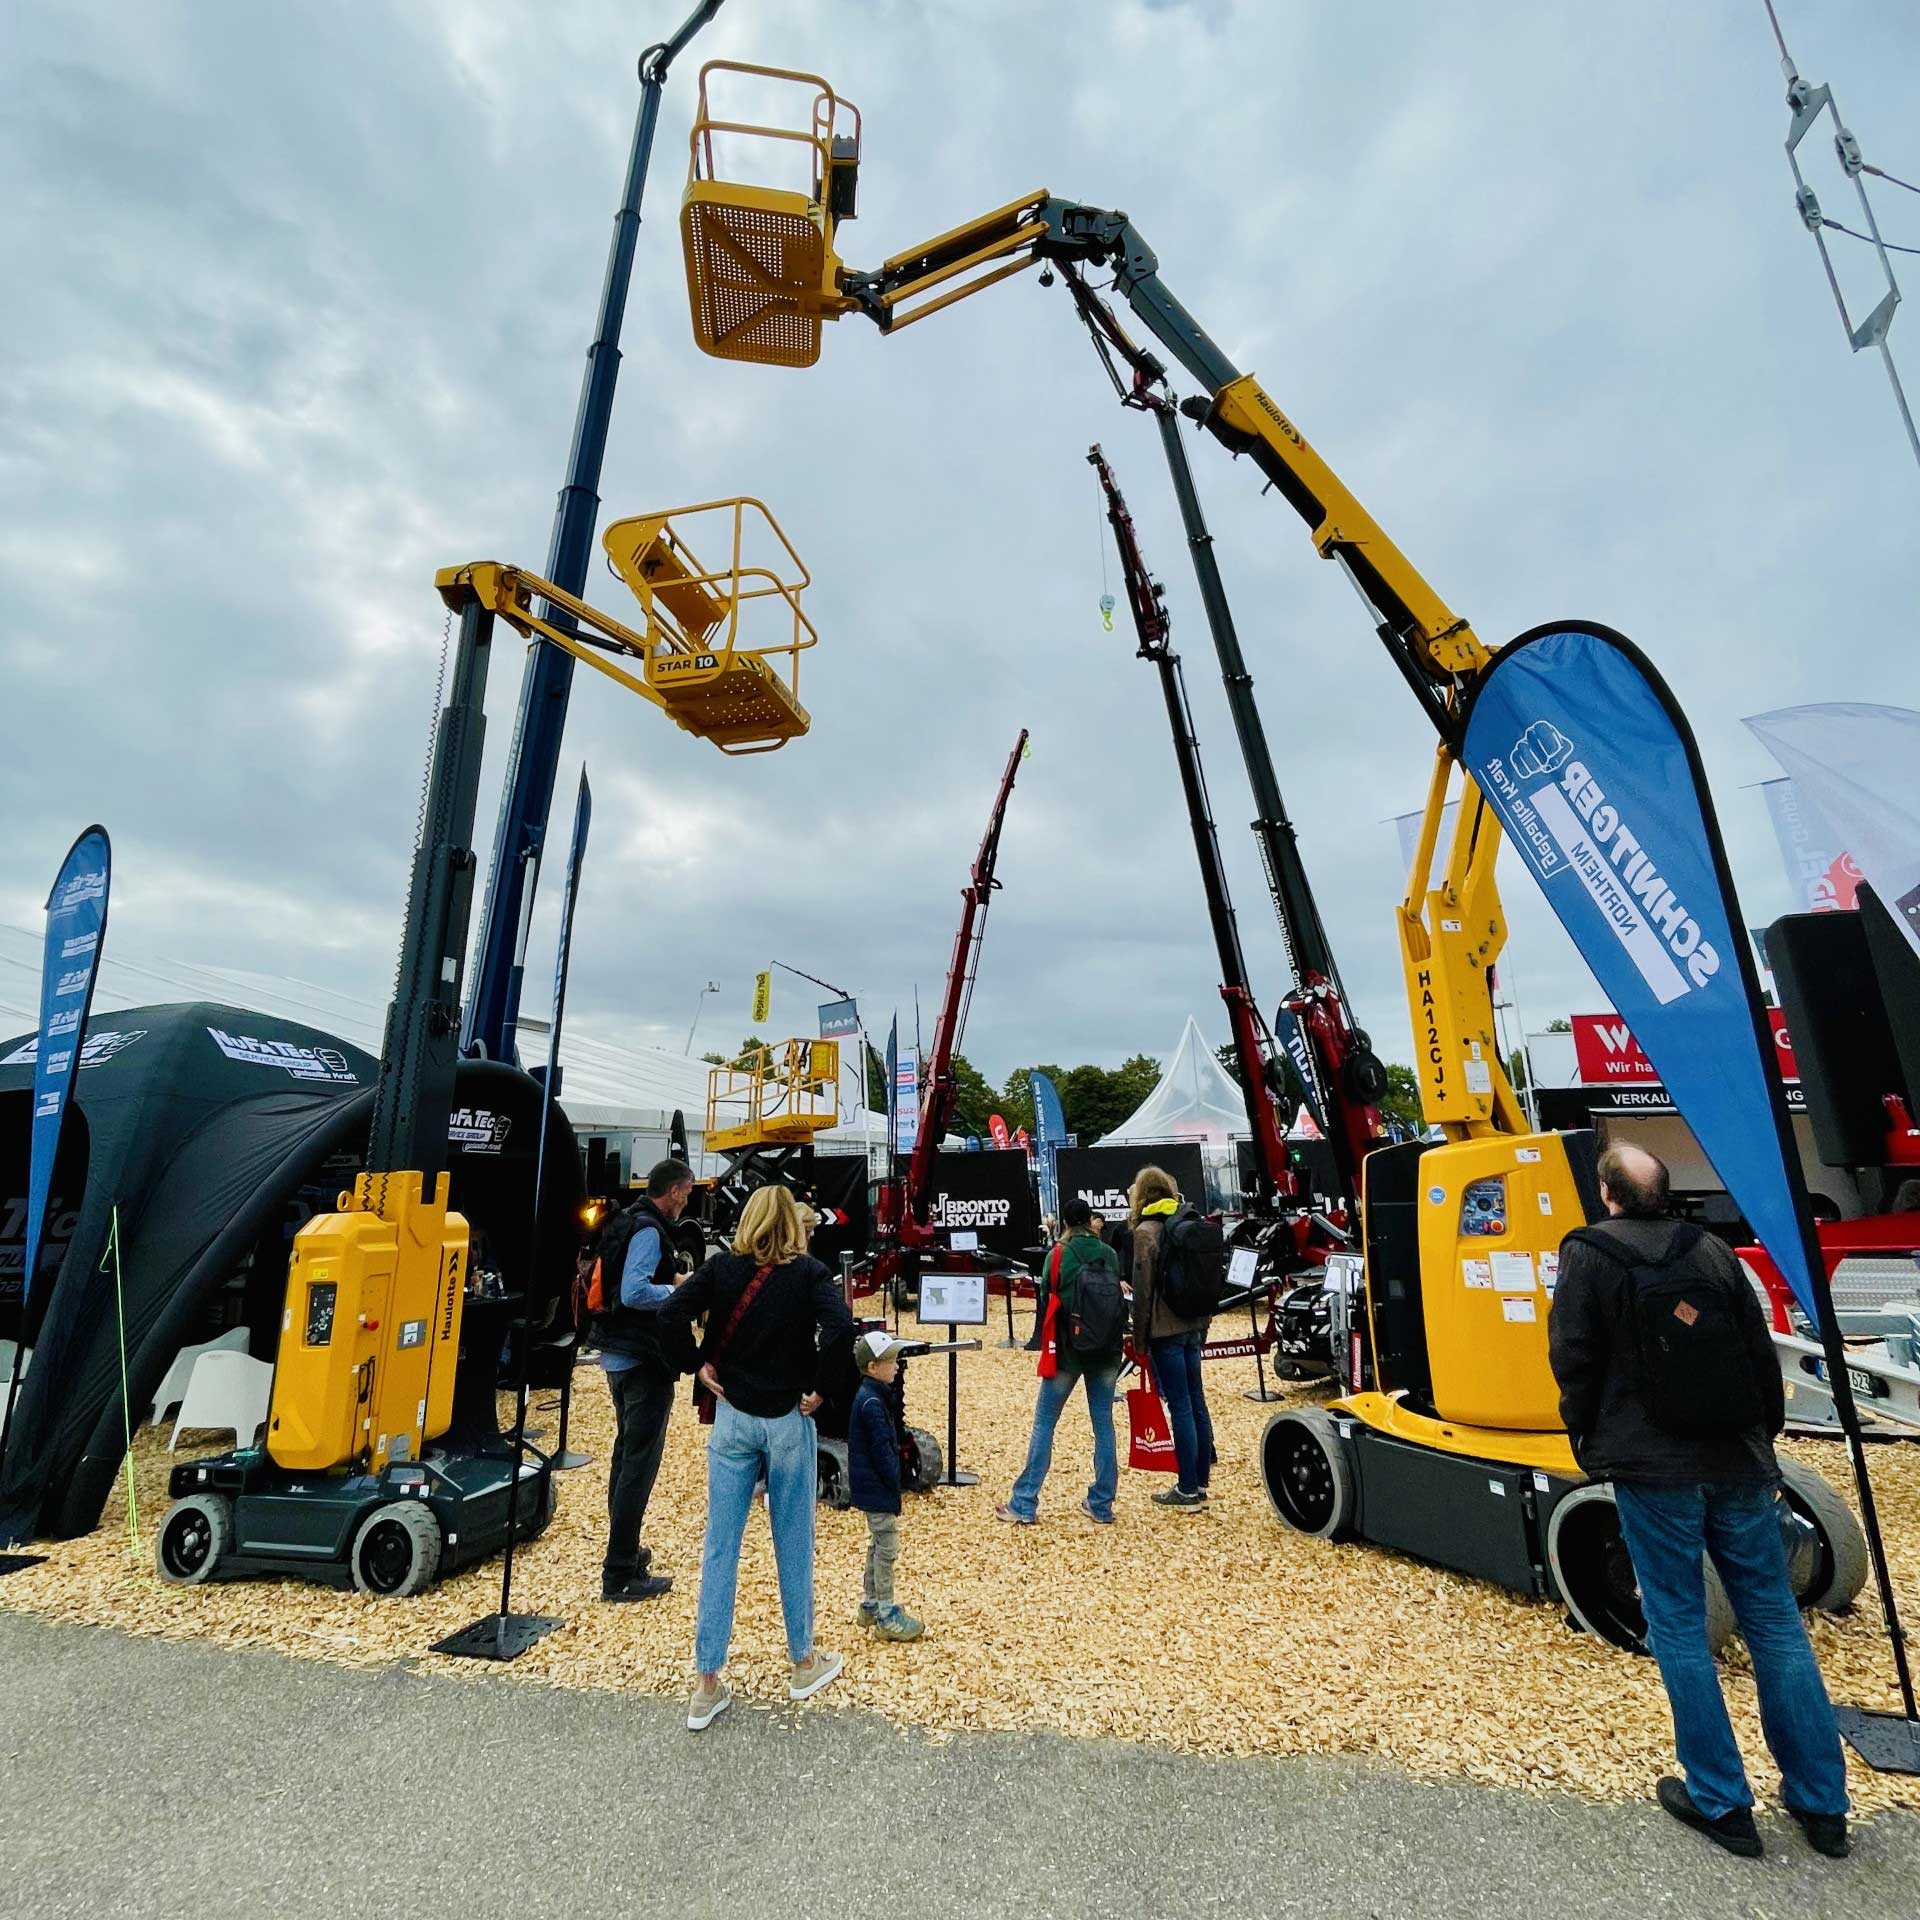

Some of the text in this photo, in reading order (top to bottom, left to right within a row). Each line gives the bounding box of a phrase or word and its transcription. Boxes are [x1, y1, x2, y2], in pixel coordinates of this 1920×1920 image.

[1254, 391, 1293, 436] Haulotte
[656, 656, 715, 673] STAR 10
[1417, 969, 1448, 1102] HA12CJ+
[238, 1051, 313, 1069] SERVICE GROUP
[1604, 1061, 1655, 1074] Wir ha
[1611, 1092, 1671, 1105] VERKAU
[946, 1199, 1010, 1213] BRONTO
[946, 1212, 1009, 1227] SKYLIFT
[441, 1276, 457, 1341] Haulotte
